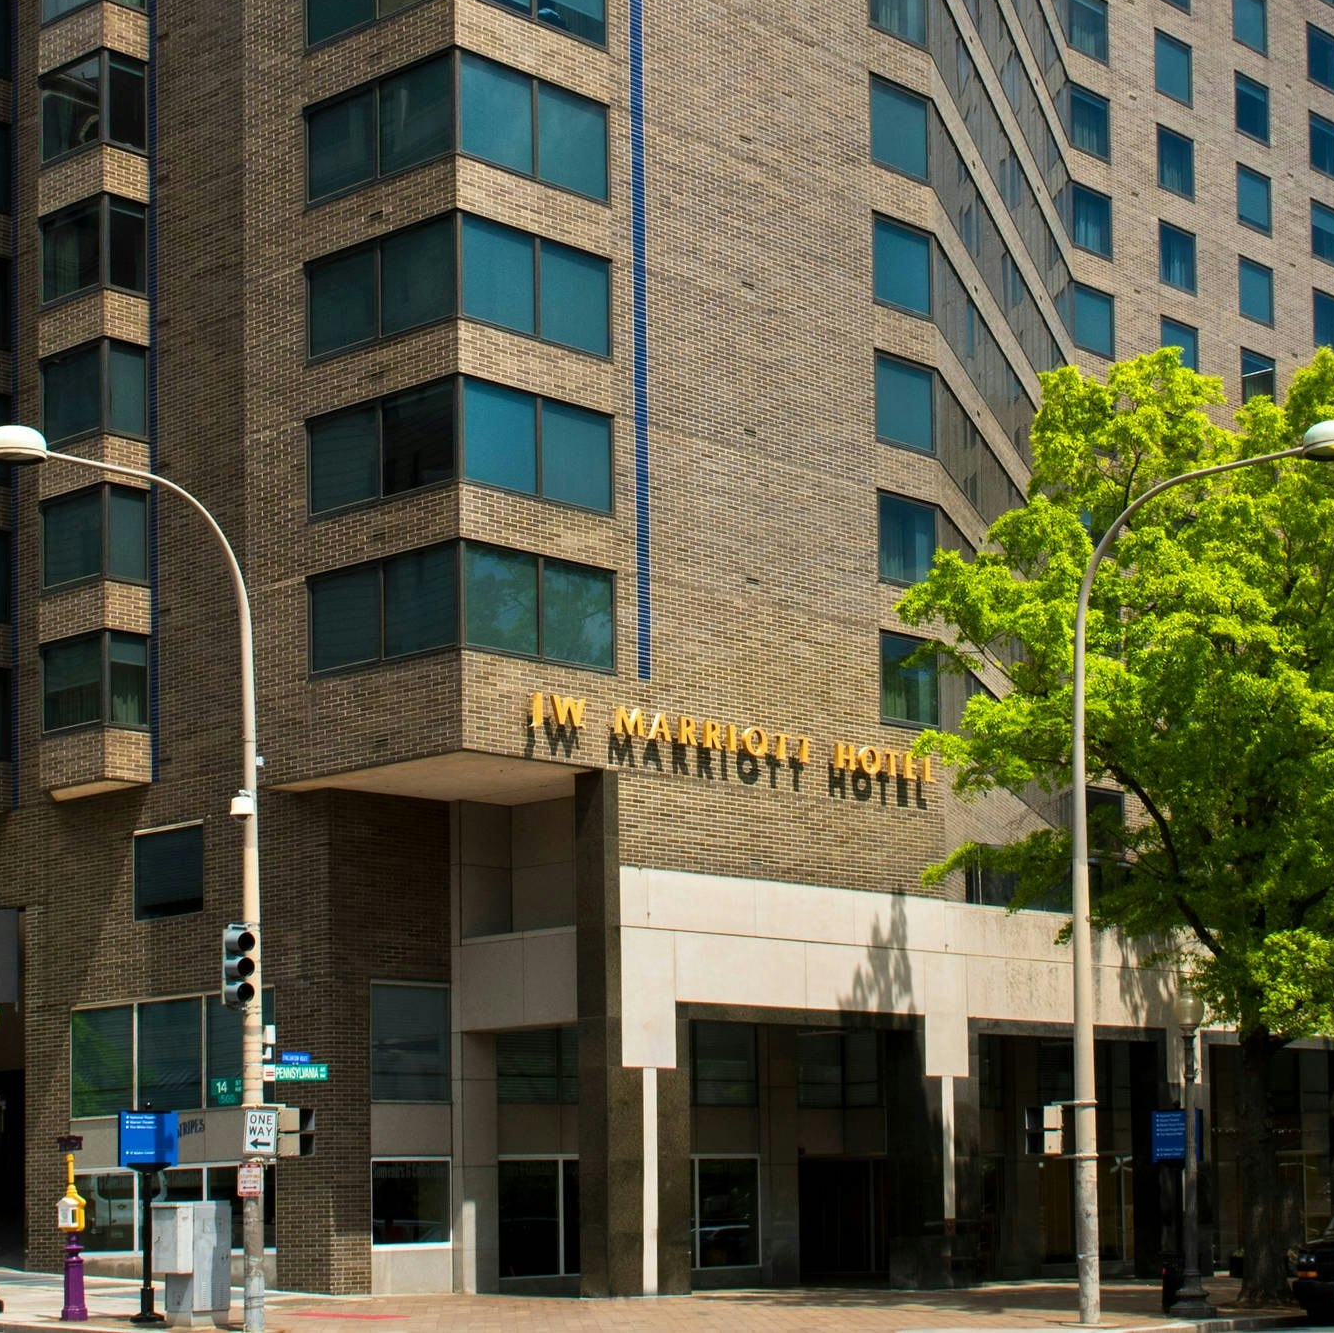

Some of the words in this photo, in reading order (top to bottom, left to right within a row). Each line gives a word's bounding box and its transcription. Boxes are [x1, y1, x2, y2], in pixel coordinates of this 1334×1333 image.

[613, 705, 813, 764] MARRIOTT
[834, 742, 937, 784] HOTEL
[276, 1067, 318, 1079] PENNSYLVANIA
[216, 1081, 227, 1093] 14
[250, 1114, 273, 1125] ONE
[177, 1118, 205, 1138] TRIPES
[249, 1126, 273, 1136] WAY
